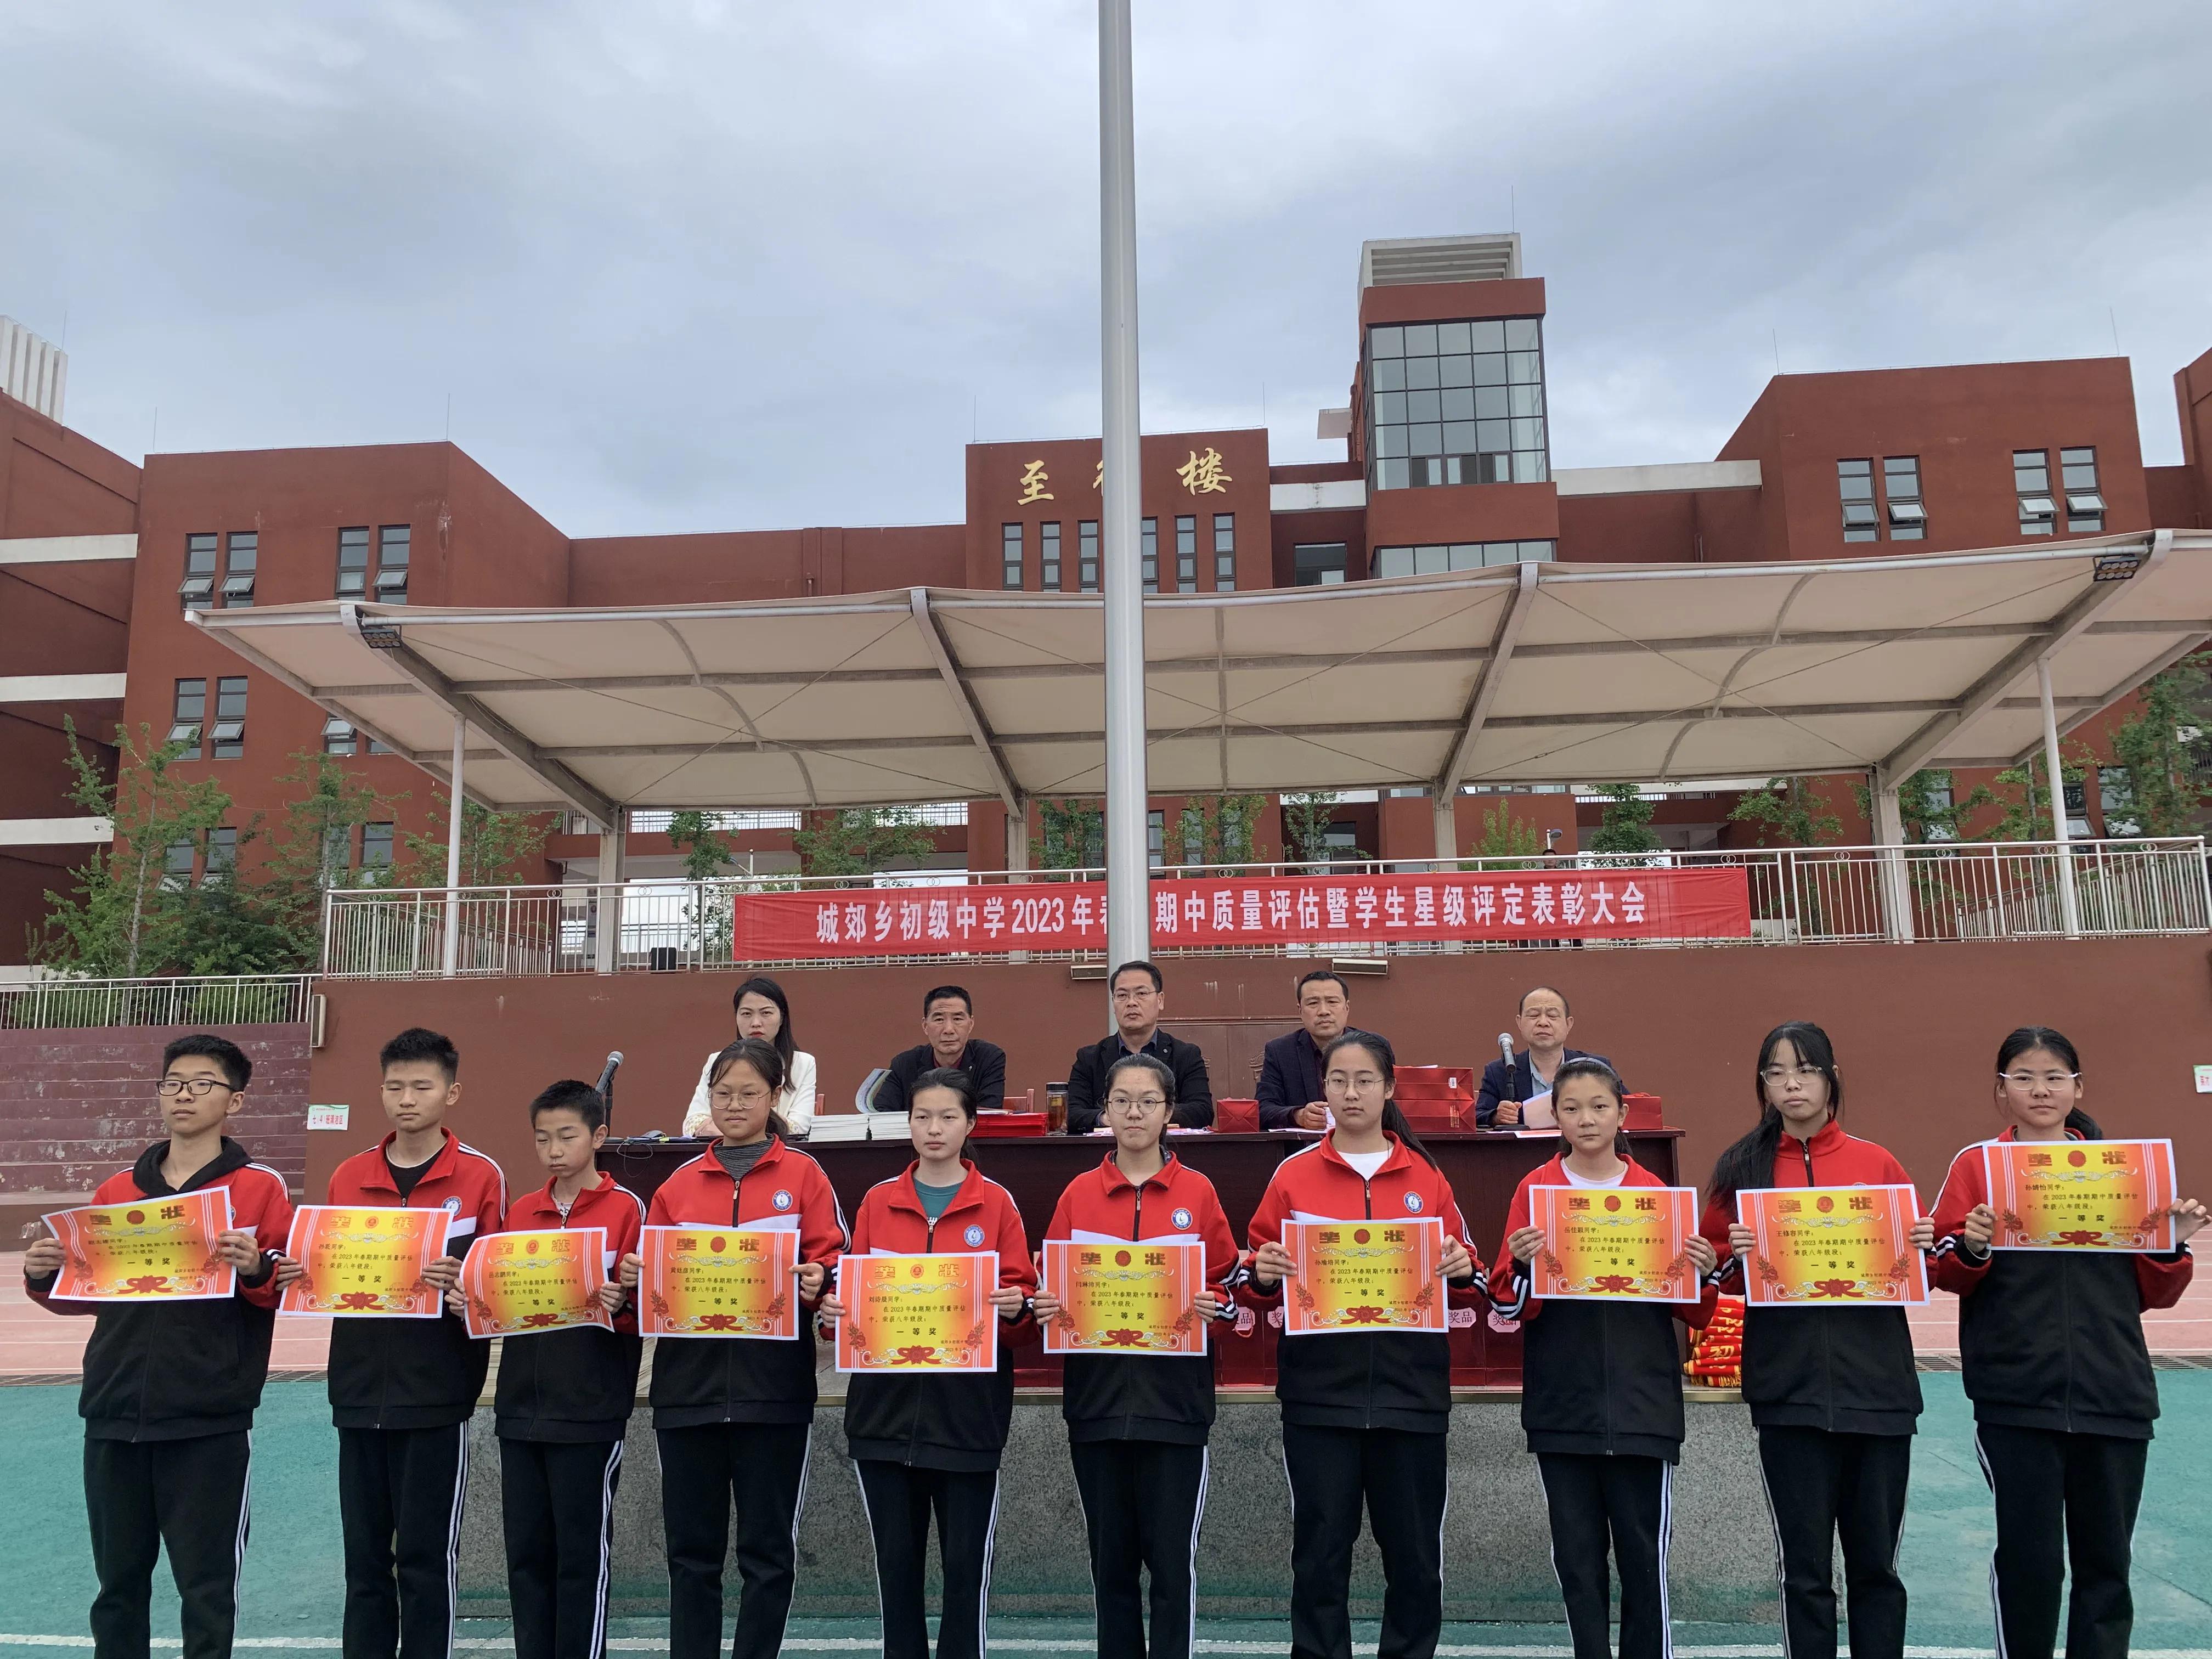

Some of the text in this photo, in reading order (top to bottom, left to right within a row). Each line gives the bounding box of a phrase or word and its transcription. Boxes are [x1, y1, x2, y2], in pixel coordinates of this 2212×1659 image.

[816, 880, 1646, 944] 城郊乡初级中学2023年期中质量评估暨学生星级评定表彰大会
[1594, 1258, 1635, 1266] 一等奖
[1811, 1261, 1855, 1269] 一等奖
[1449, 1311, 1472, 1323] 奖品
[896, 1327, 936, 1335] 一等奖
